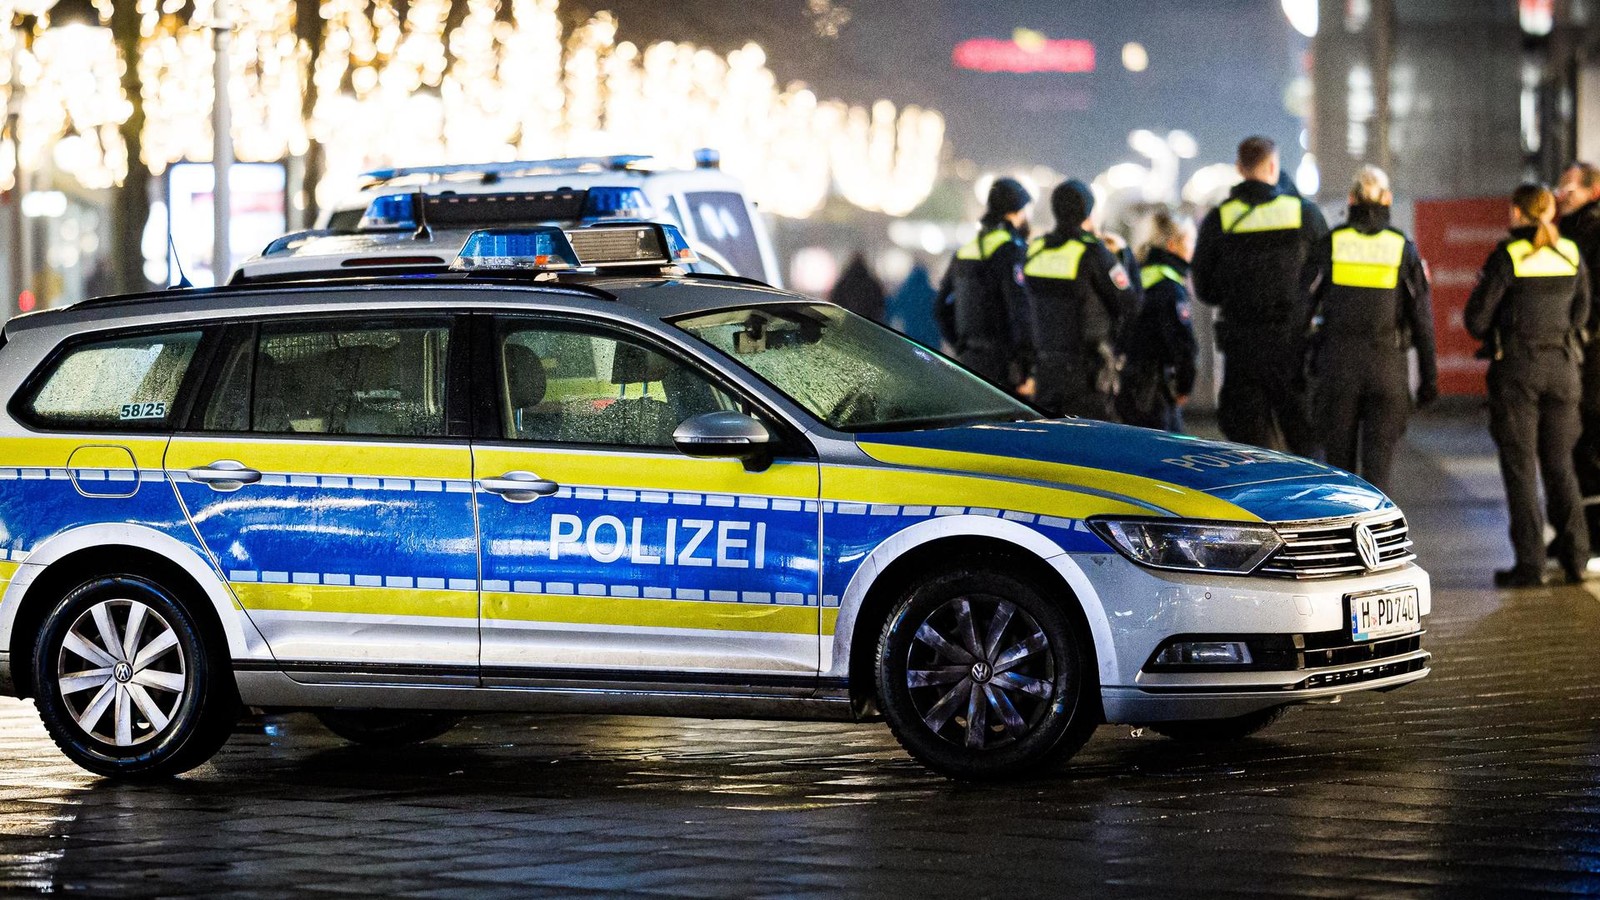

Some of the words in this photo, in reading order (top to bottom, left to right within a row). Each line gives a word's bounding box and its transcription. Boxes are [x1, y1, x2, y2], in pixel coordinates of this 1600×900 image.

[120, 402, 165, 418] 58/25
[1160, 449, 1276, 473] POLIZE
[549, 512, 767, 570] POLIZEI
[1361, 601, 1371, 629] H
